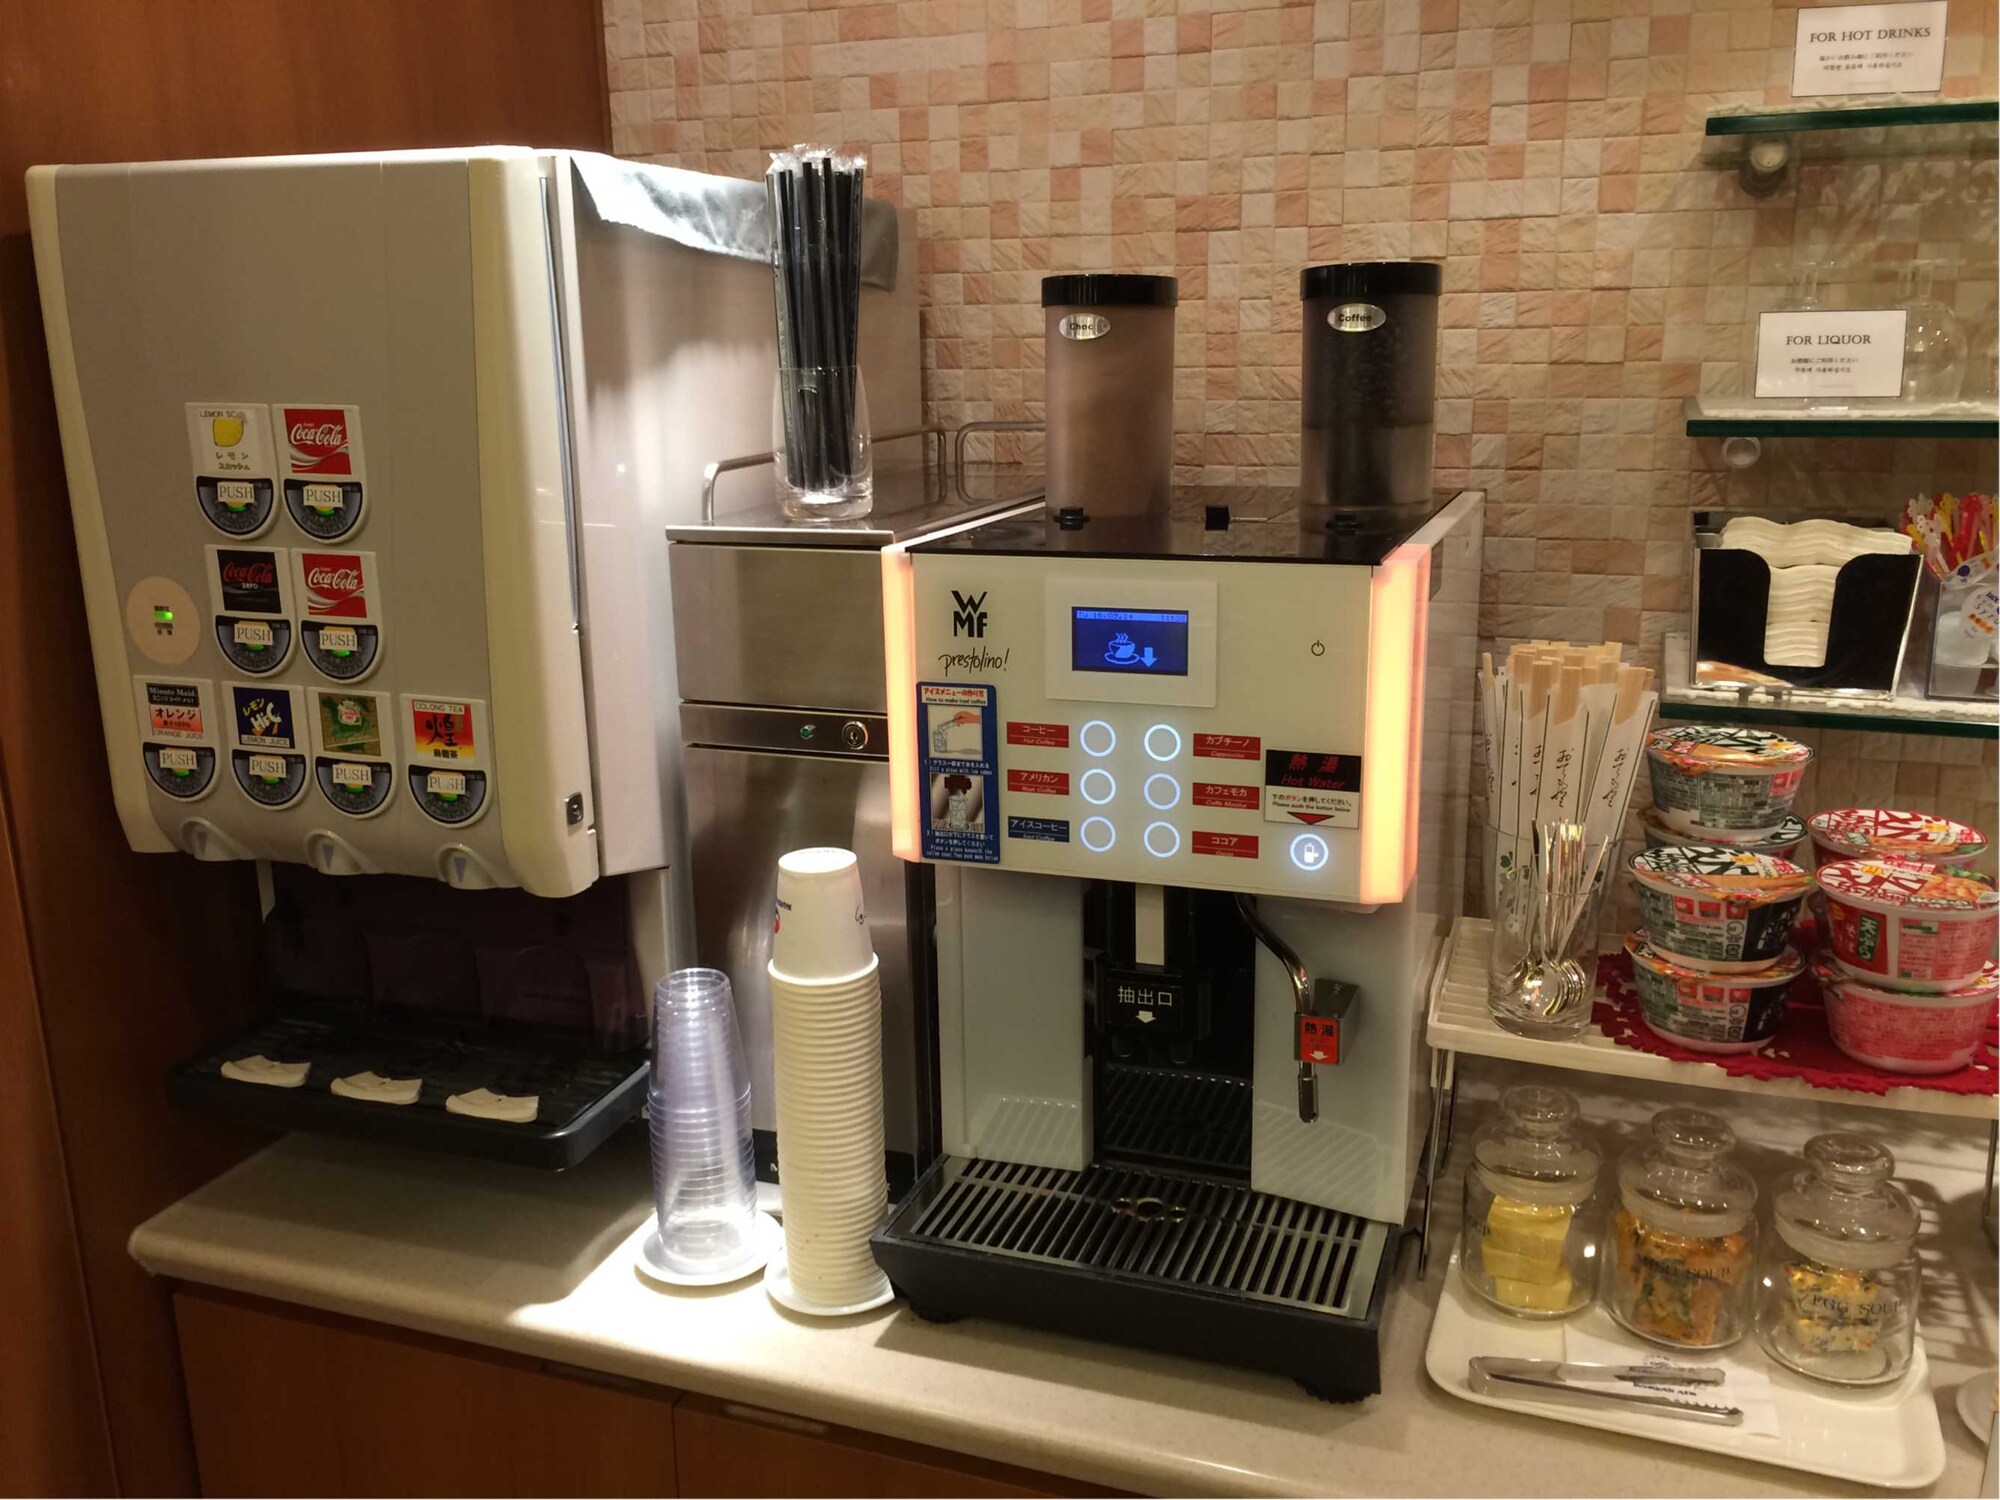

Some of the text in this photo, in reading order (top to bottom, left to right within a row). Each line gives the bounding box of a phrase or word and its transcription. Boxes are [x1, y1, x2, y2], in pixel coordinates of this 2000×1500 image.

[1809, 27, 1932, 43] FOR HOT DRINKS
[1338, 313, 1372, 322] Coffee
[1070, 322, 1094, 331] Choc
[1786, 334, 1872, 346] FOR LIQUOR
[291, 422, 345, 446] Coca-Cola
[219, 485, 254, 500] PUSH
[306, 488, 342, 504] PUSH
[307, 566, 361, 590] Coca-Cola
[236, 626, 272, 641] PUSH
[320, 632, 357, 648] PUSH
[938, 645, 1010, 677] prestolino!
[176, 688, 196, 697] Maid
[155, 707, 196, 720] オレンジ
[415, 702, 464, 713] OOLONG TEA
[1022, 725, 1056, 735] コーヒー
[242, 736, 267, 744] LEMON
[161, 752, 196, 767] PUSH
[250, 759, 286, 775] PUSH
[334, 766, 371, 782] PUSH
[1019, 772, 1059, 784] アメリカン
[1280, 773, 1348, 789] Hot Water
[428, 775, 465, 791] PUSH
[1205, 784, 1248, 798] カフェモカ
[1291, 802, 1304, 810] push
[1010, 819, 1068, 832] アイスコーヒー
[1210, 836, 1239, 847] ココア
[1117, 985, 1173, 1007] 抽出口
[1857, 1299, 1903, 1316] SOUP
